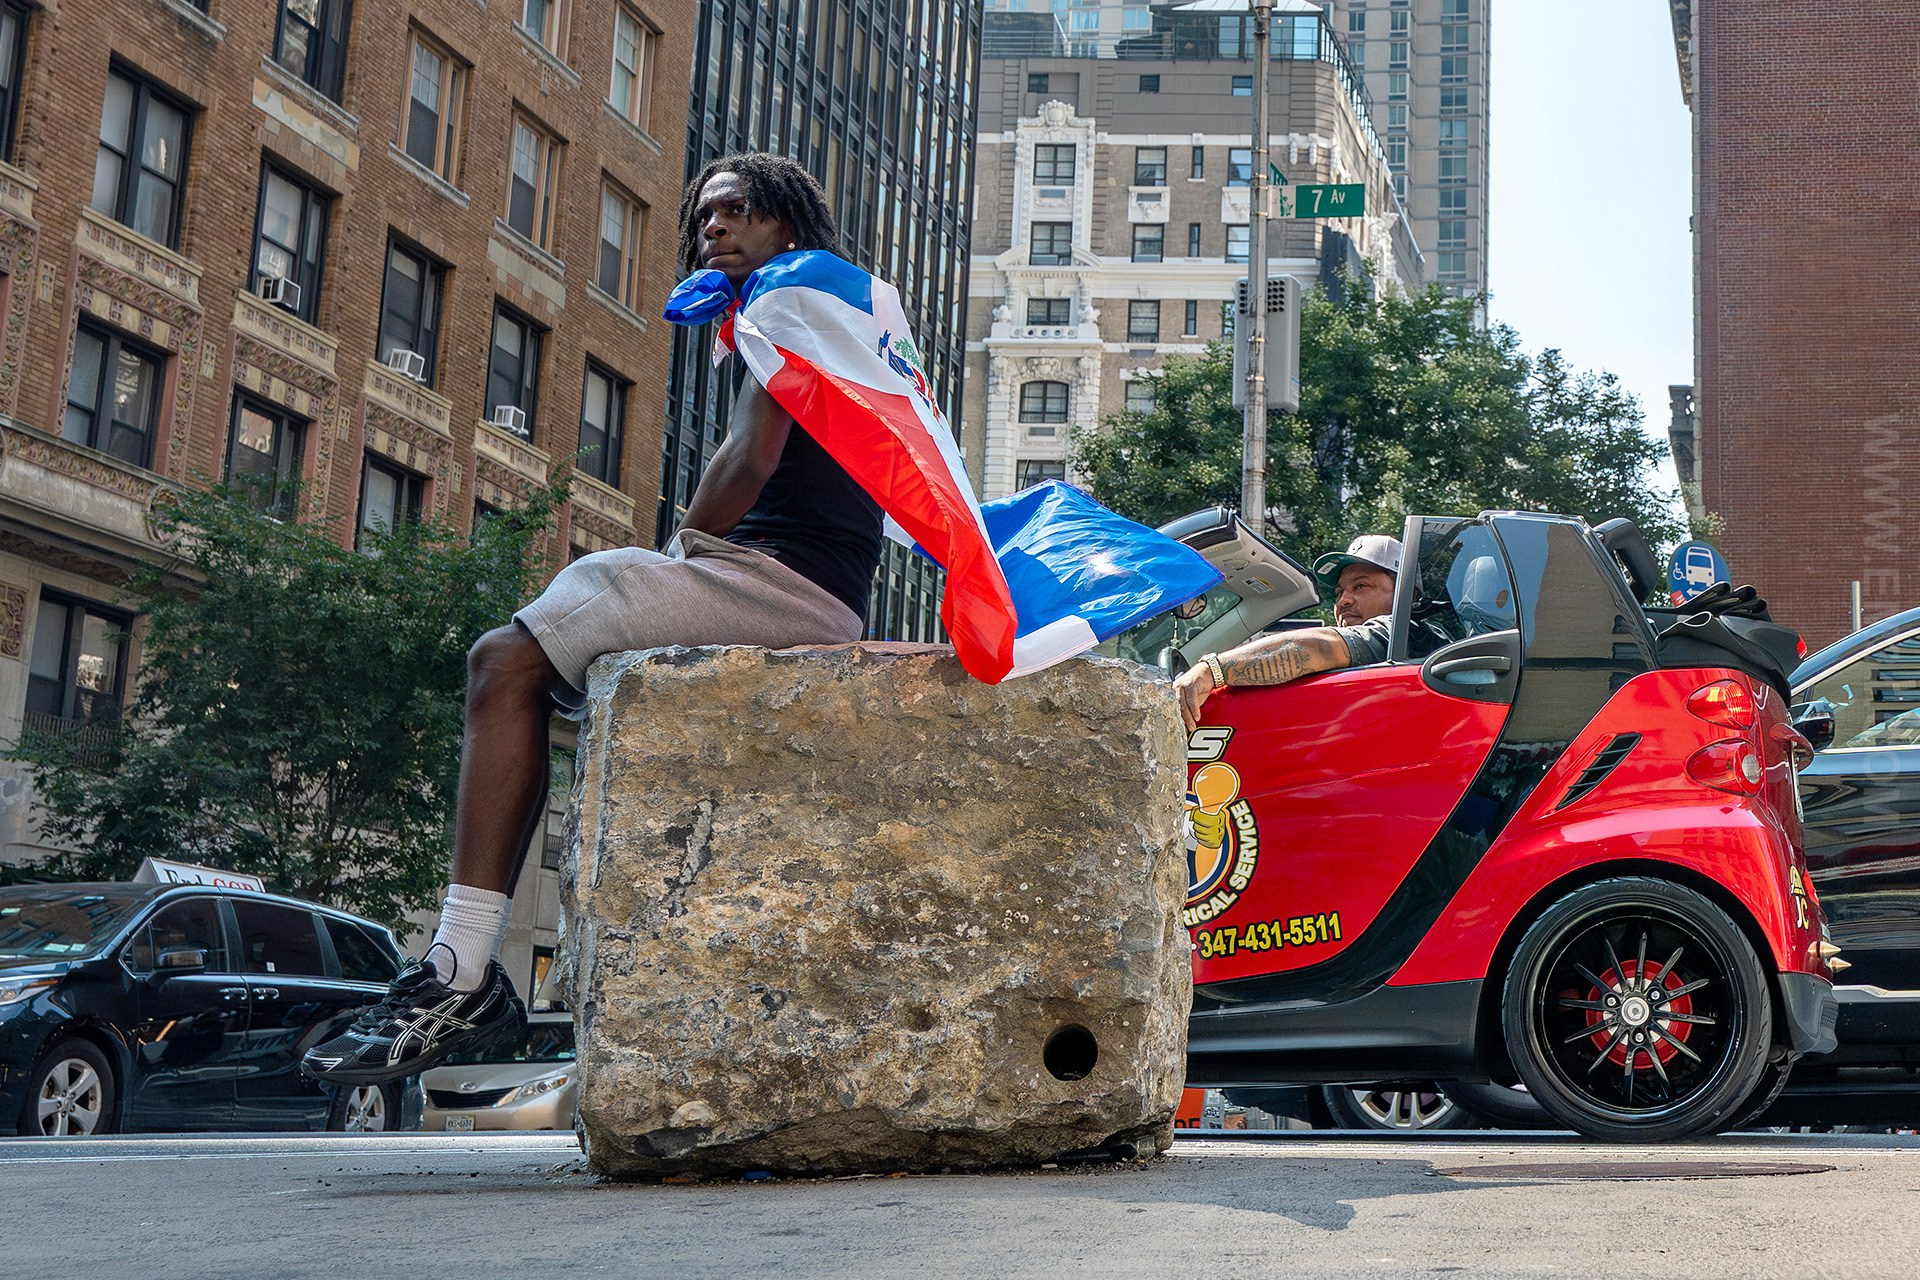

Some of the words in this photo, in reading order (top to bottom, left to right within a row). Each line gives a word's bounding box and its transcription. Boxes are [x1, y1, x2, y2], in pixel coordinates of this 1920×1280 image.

[1311, 189, 1323, 214] 7
[1330, 189, 1346, 204] Av
[1228, 800, 1258, 891] SERVICE
[1198, 912, 1342, 958] 347-431-5511
